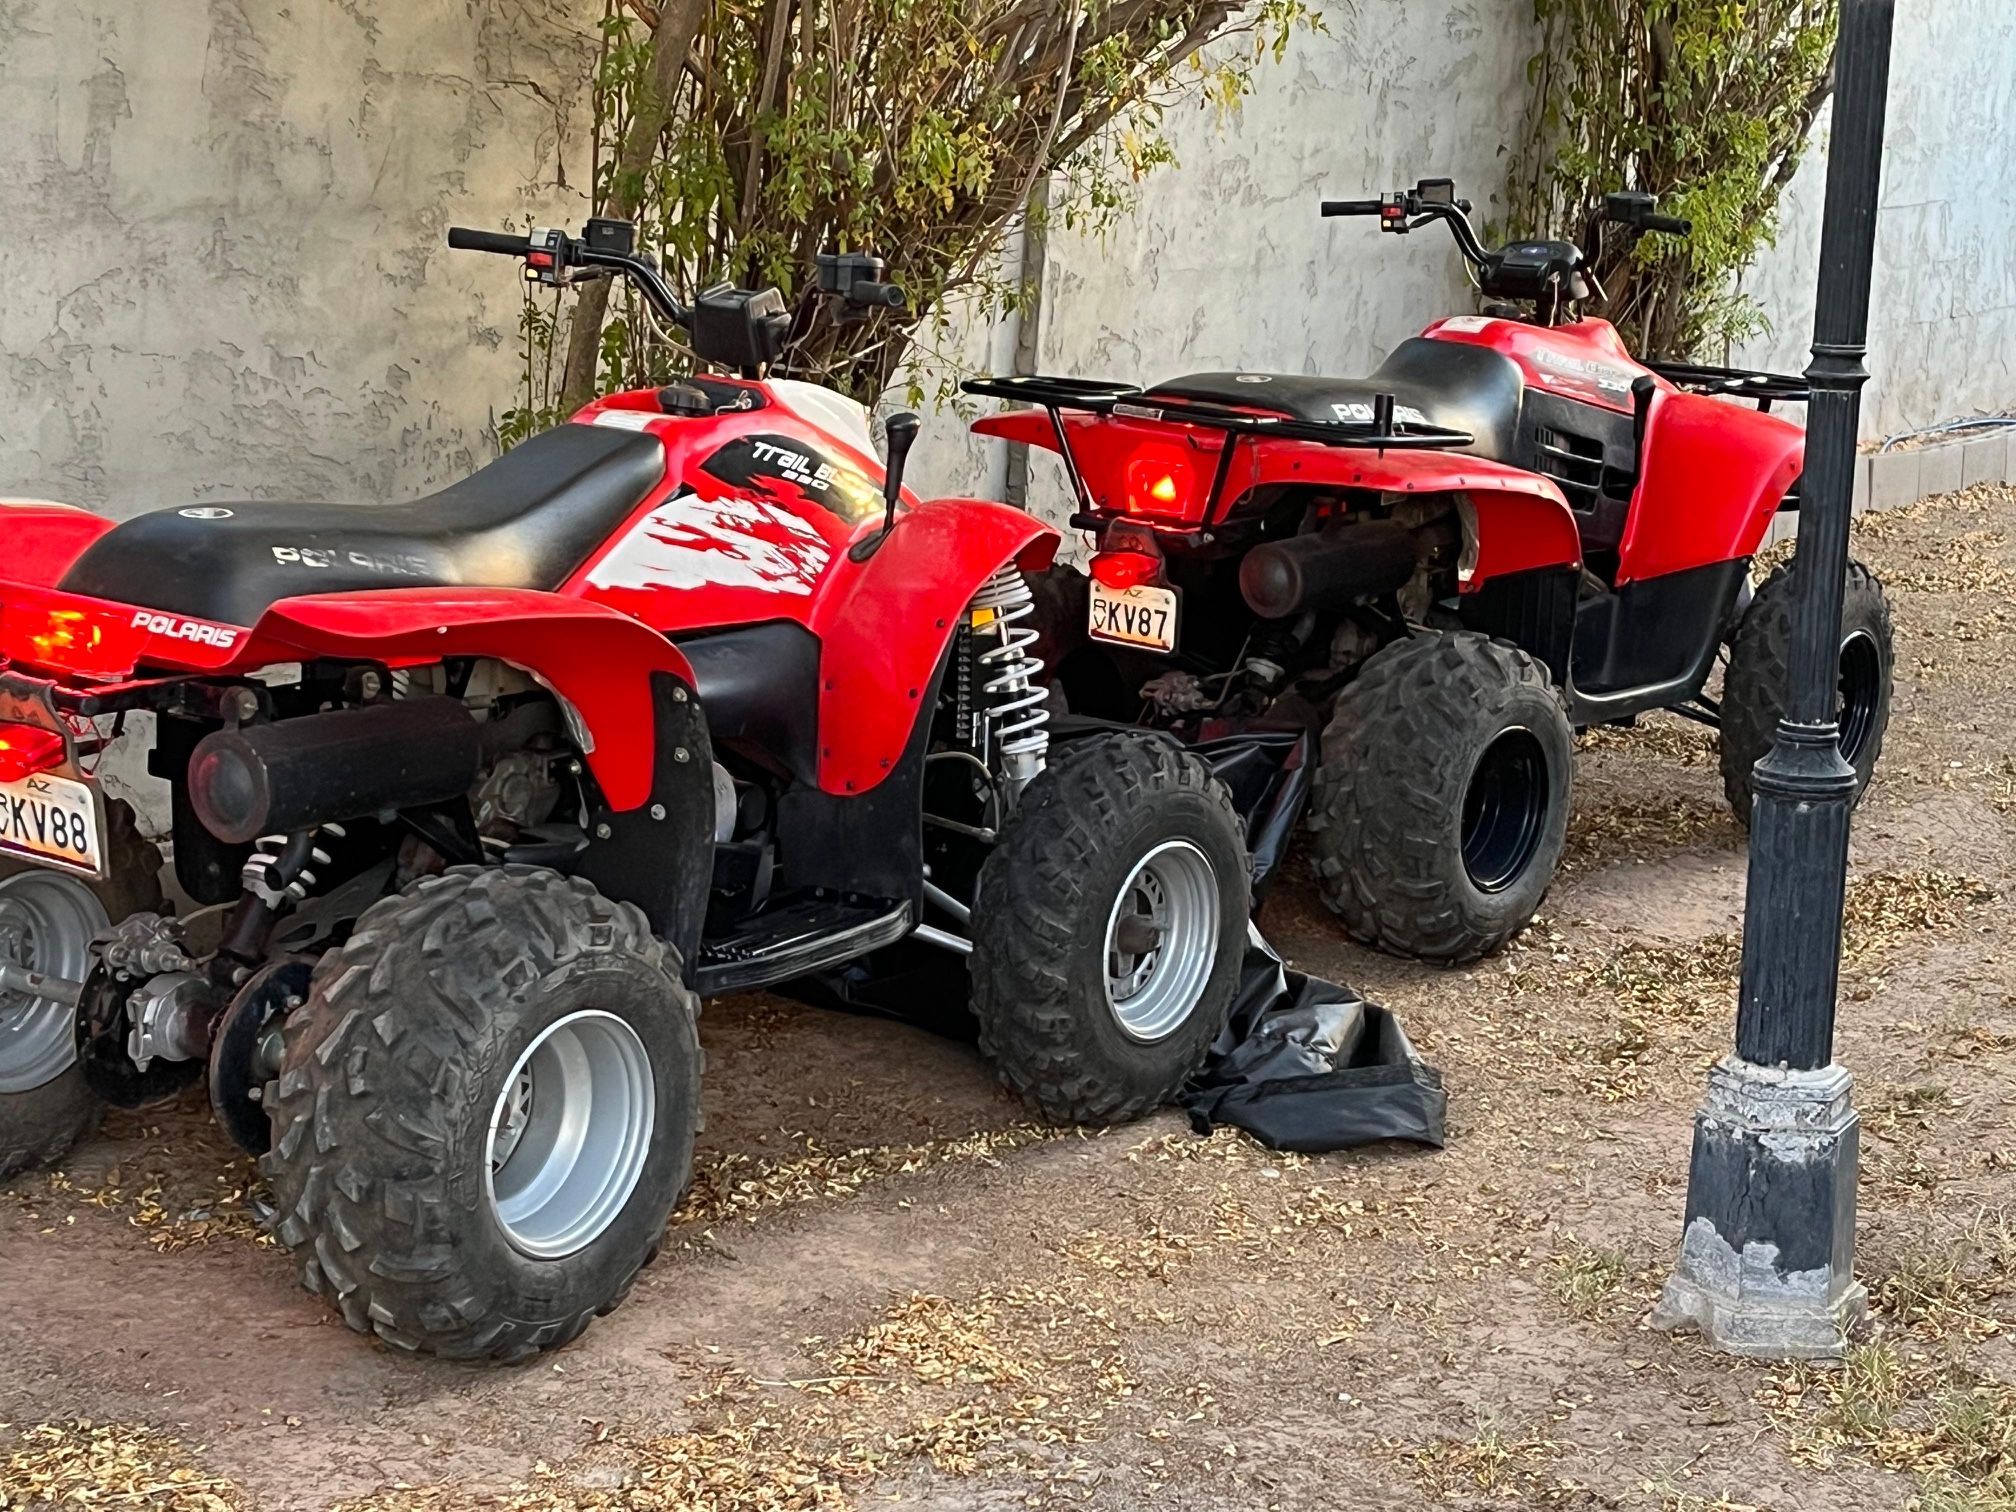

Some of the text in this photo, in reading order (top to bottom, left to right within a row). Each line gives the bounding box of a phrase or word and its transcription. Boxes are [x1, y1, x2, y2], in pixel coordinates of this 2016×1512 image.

[130, 611, 237, 648] POLARIS
[1108, 601, 1168, 640] KV87
[27, 778, 52, 794] AZ
[11, 794, 87, 855] KV88
